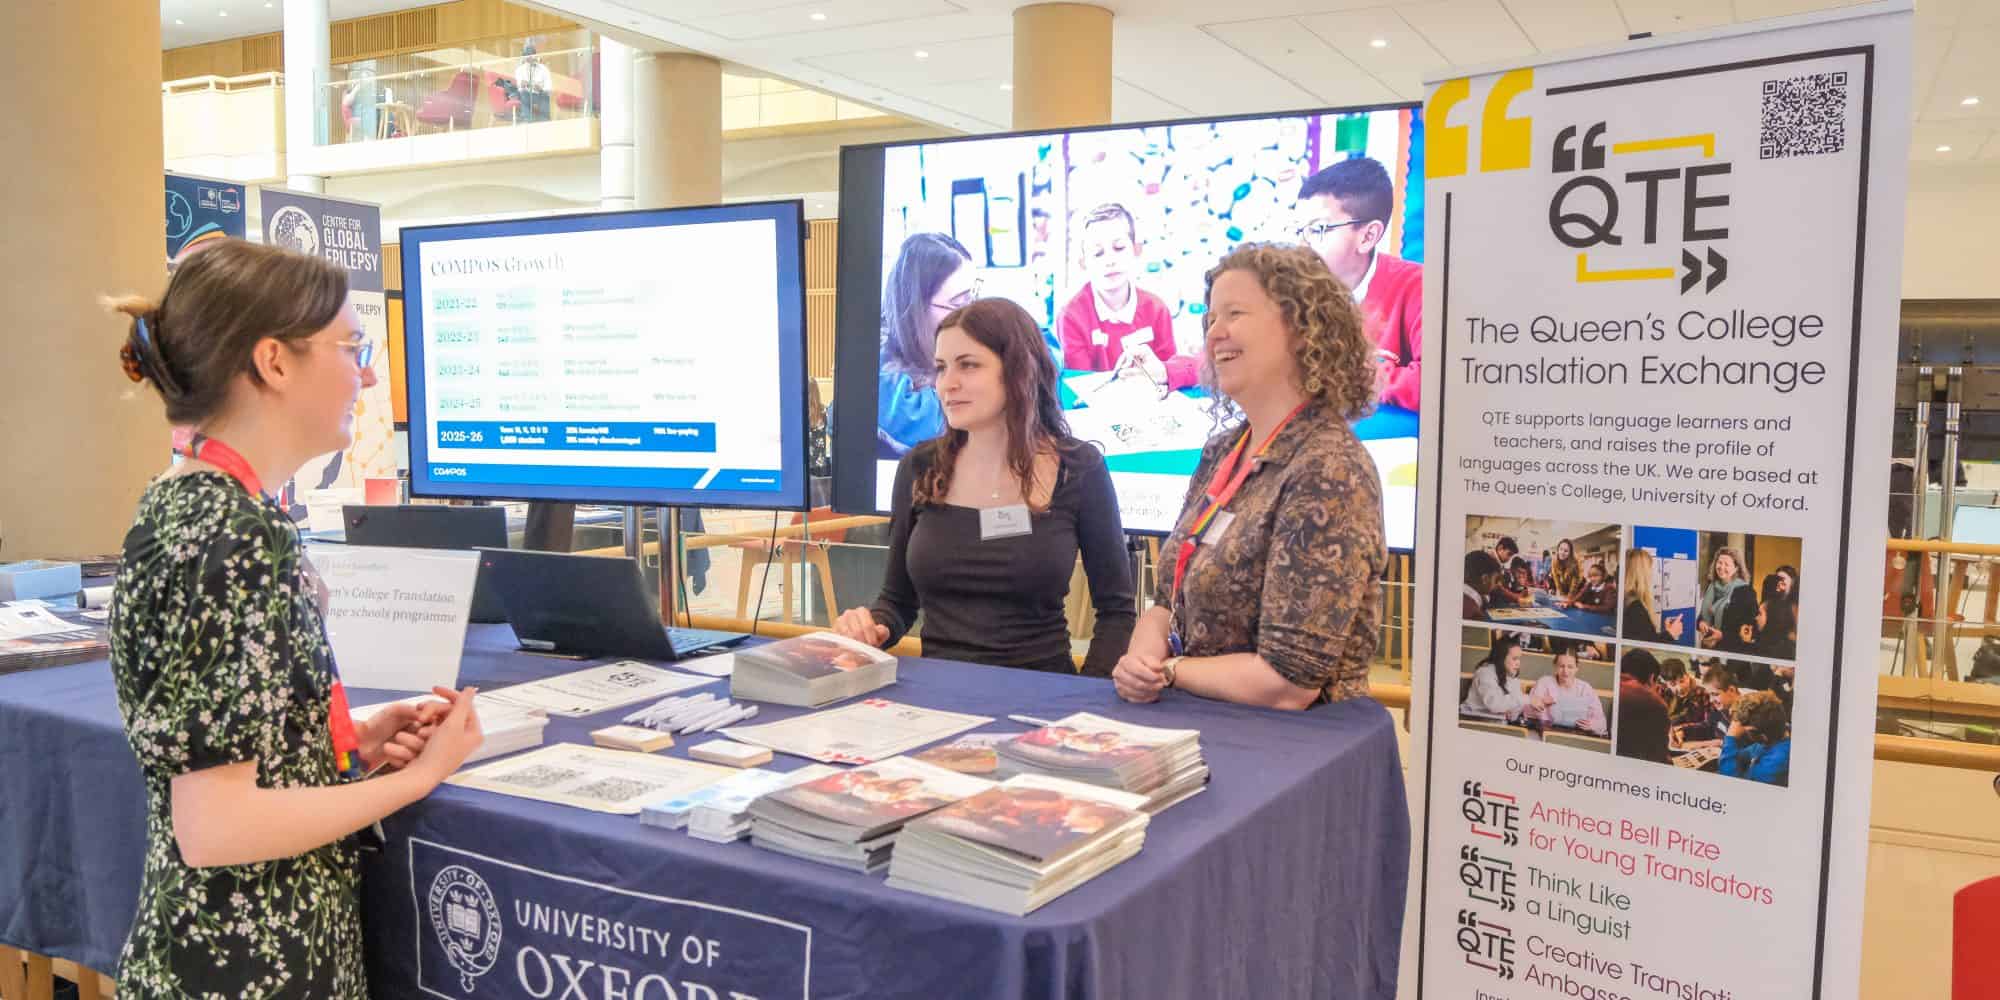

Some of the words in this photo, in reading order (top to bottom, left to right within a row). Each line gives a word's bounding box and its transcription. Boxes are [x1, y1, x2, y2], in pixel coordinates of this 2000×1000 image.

[1549, 162, 1731, 248] QTE
[322, 214, 348, 230] CENTRE
[348, 218, 361, 232] FOR
[323, 228, 368, 251] GLOBAL
[325, 248, 378, 272] EPILEPSY
[431, 256, 500, 276] COMPOS
[504, 251, 567, 274] Growth
[353, 304, 381, 316] PILEPSY
[1466, 317, 1519, 344] The
[1530, 312, 1665, 343] Queen's
[1678, 309, 1824, 347] College
[1461, 356, 1628, 385] Translation
[1640, 355, 1826, 393] Exchange
[440, 430, 483, 442] 2025-26
[1482, 411, 1510, 427] QTE
[1514, 413, 1585, 431] supports
[1588, 413, 1672, 432] language
[1676, 414, 1749, 431] learners
[1753, 416, 1792, 432] and
[1493, 434, 1566, 452] teachers,
[1570, 436, 1602, 452] and
[1607, 438, 1657, 453] raises
[1662, 439, 1691, 455] the
[1696, 440, 1752, 459] profile
[1756, 441, 1776, 457] of
[1459, 455, 1542, 475] languages
[1545, 459, 1599, 475] across
[1603, 461, 1631, 477] the
[1635, 463, 1661, 478] UK.
[1666, 464, 1693, 480] We
[1698, 468, 1728, 481] are
[1733, 466, 1792, 484] based
[1797, 470, 1819, 486] at
[1464, 478, 1490, 494] The
[1494, 479, 1557, 497] Queen's
[1561, 483, 1627, 502] College,
[1631, 487, 1716, 509] University
[1720, 490, 1738, 507] of
[1742, 492, 1809, 512] Oxford.
[352, 586, 390, 602] College
[392, 588, 456, 603] Translation
[350, 606, 390, 619] schools
[392, 609, 456, 624] programme
[1505, 758, 1535, 775] Our
[1538, 765, 1651, 799] programmes
[1656, 785, 1728, 815] include:
[1462, 797, 1519, 831] QTE
[1529, 800, 1612, 837] Anthea
[1620, 819, 1660, 848] Bell
[1667, 829, 1721, 861] Prize
[1459, 862, 1517, 898] QTE
[1528, 827, 1557, 852] for
[1563, 835, 1636, 876] Young
[1643, 853, 1773, 905] Translators
[1527, 866, 1582, 899] Think
[1589, 881, 1631, 911] Like
[515, 899, 671, 957] UNIVERSITY
[682, 936, 721, 968] OF
[1526, 900, 1541, 916] a
[1548, 900, 1632, 941] Linguist
[1457, 926, 1516, 965] QTE
[1526, 935, 1623, 980] Creative
[517, 946, 760, 1000] OXFO
